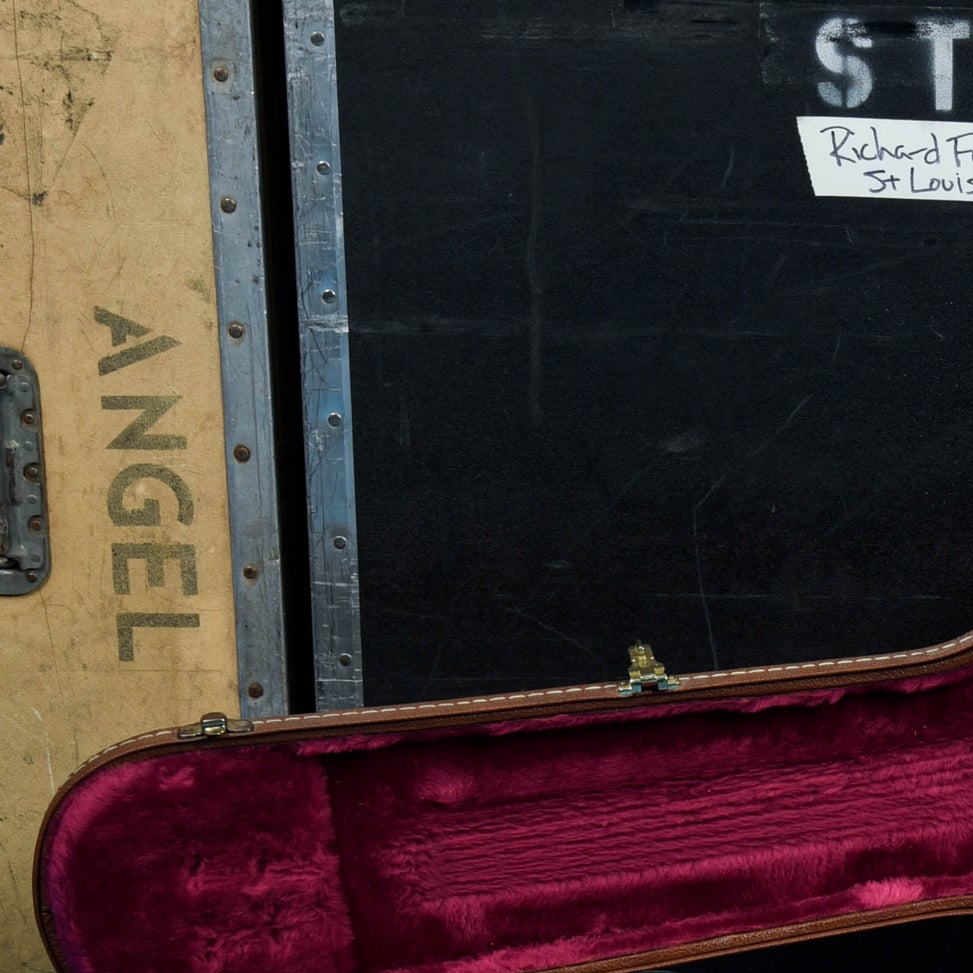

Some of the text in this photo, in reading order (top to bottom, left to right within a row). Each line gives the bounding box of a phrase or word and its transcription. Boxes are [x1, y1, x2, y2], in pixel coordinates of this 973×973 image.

[820, 126, 941, 167] Richard
[863, 169, 900, 193] St
[94, 305, 200, 662] ANGEL
